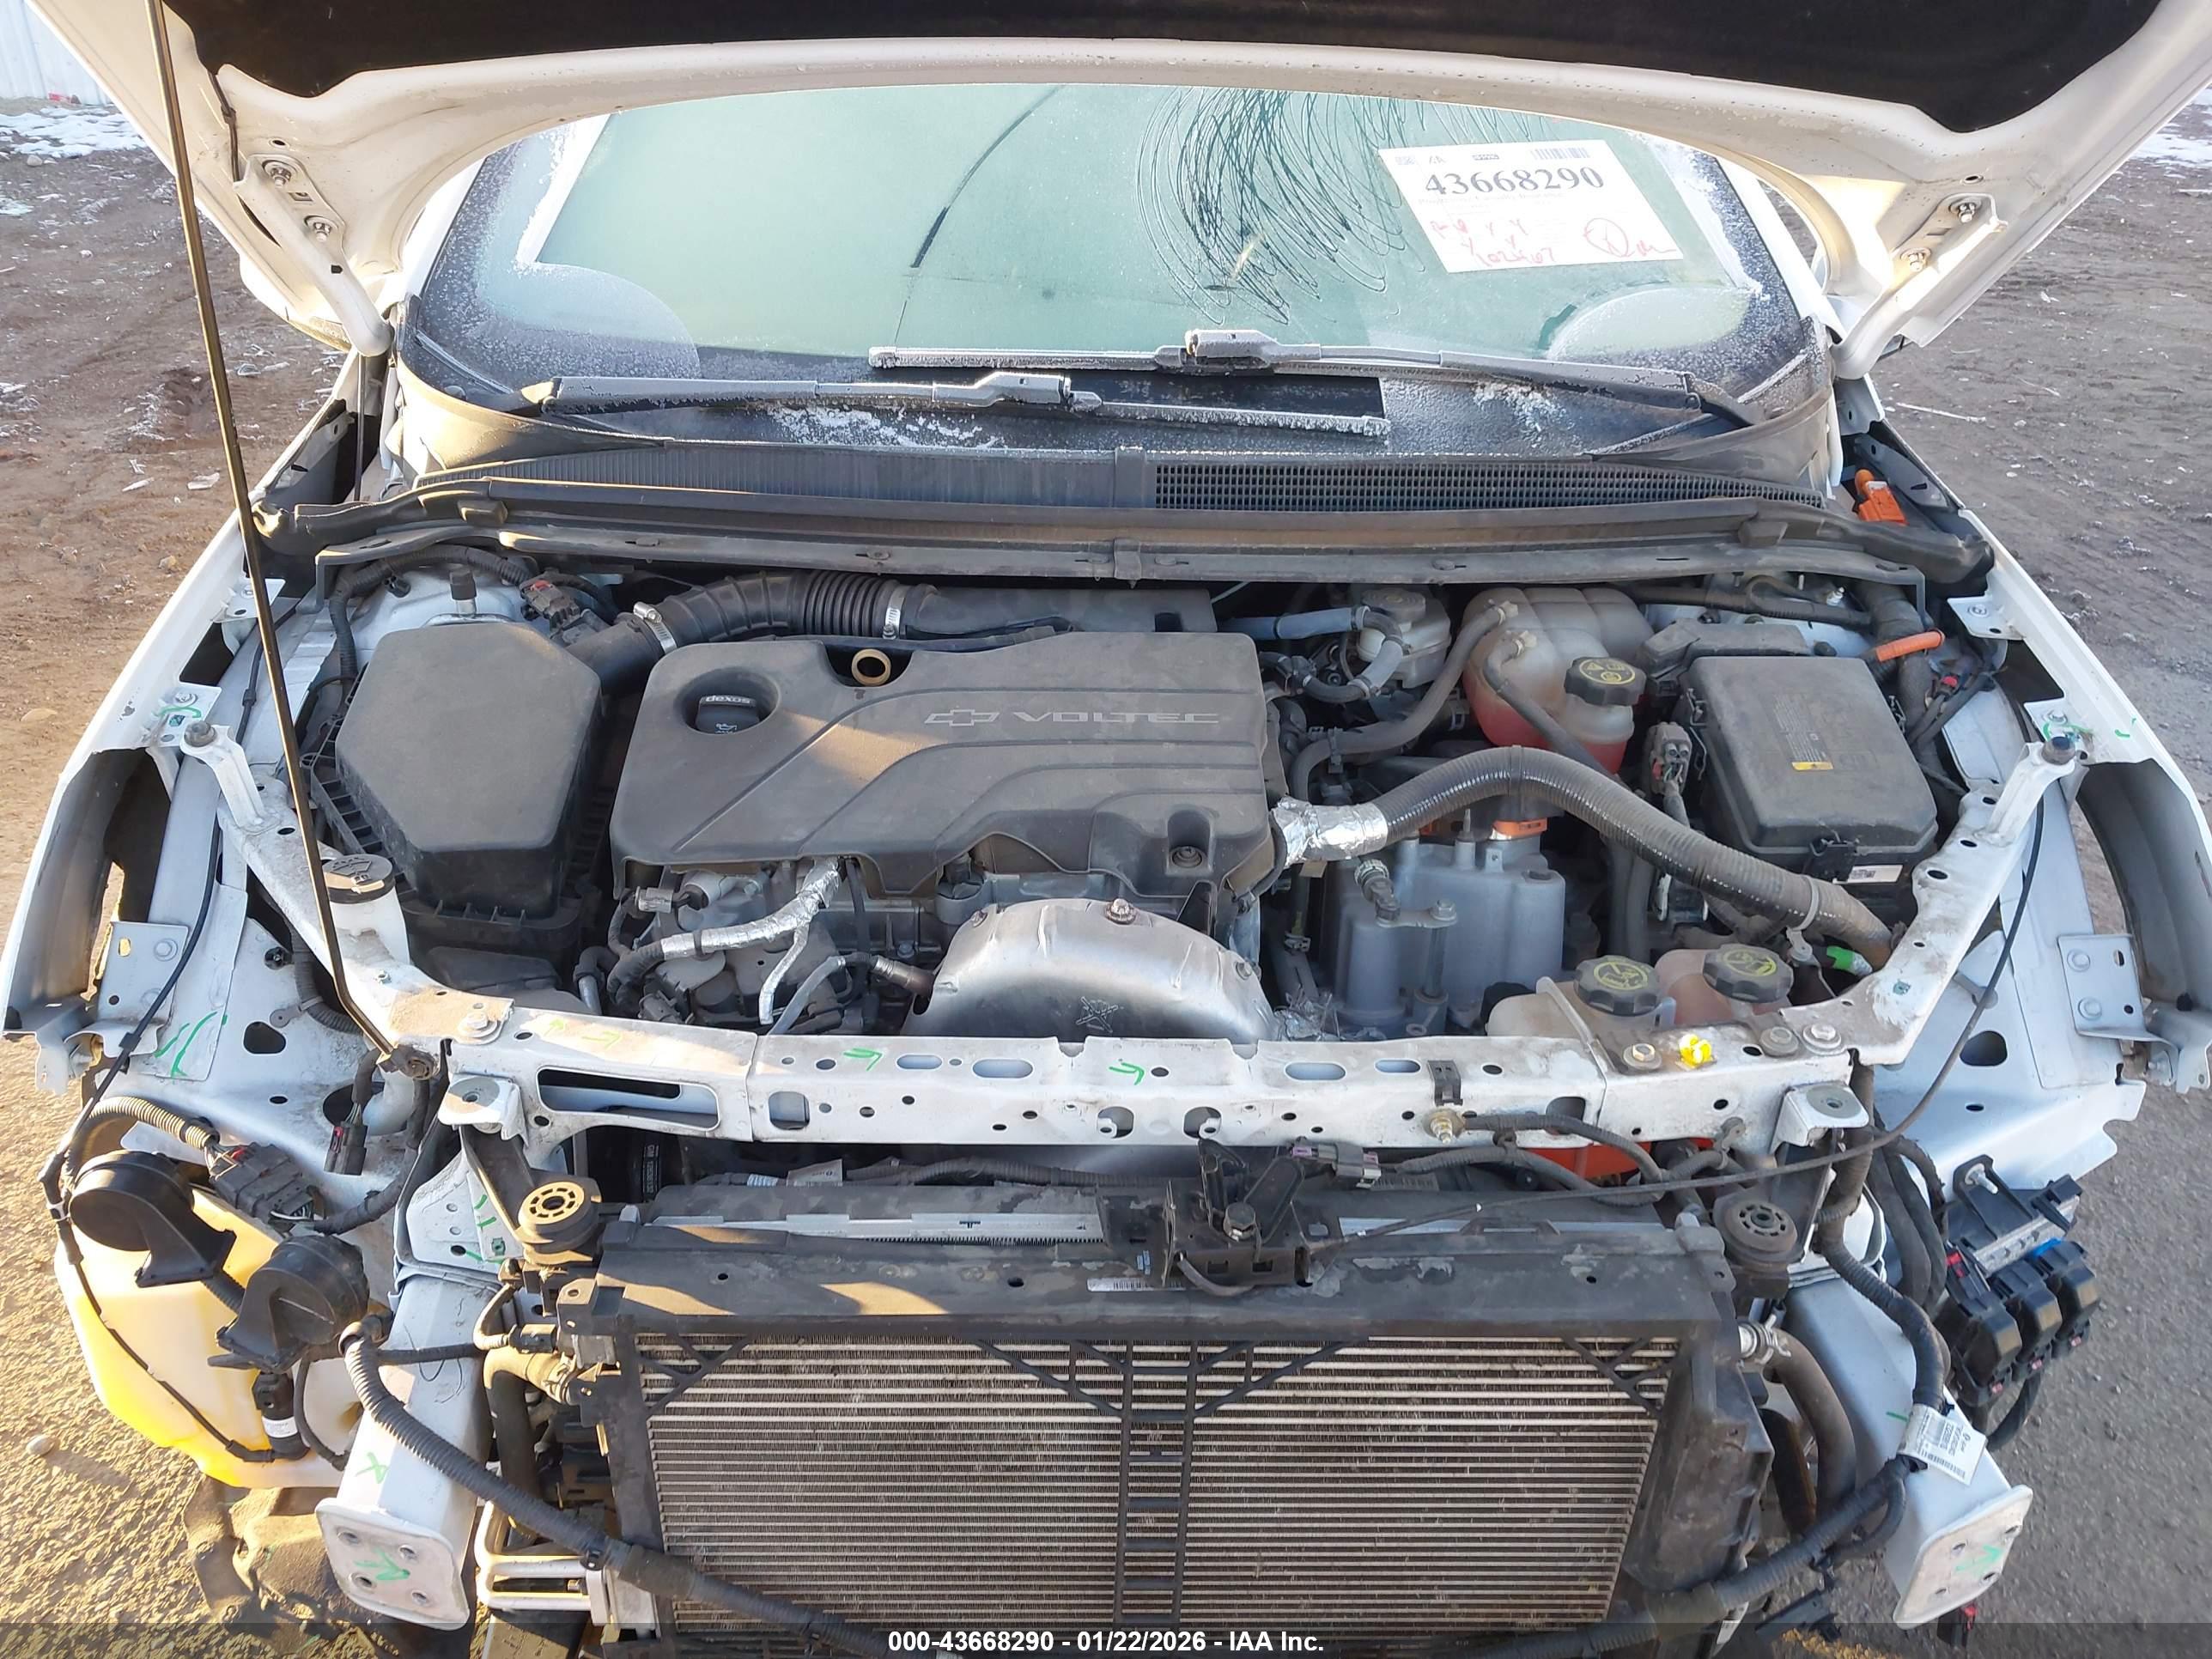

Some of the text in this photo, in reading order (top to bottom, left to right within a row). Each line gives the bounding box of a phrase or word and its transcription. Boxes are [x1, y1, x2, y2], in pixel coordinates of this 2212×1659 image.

[1425, 166, 1605, 195] 43668290
[705, 695, 750, 704] dexos
[1013, 712, 1219, 724] VOLTEC
